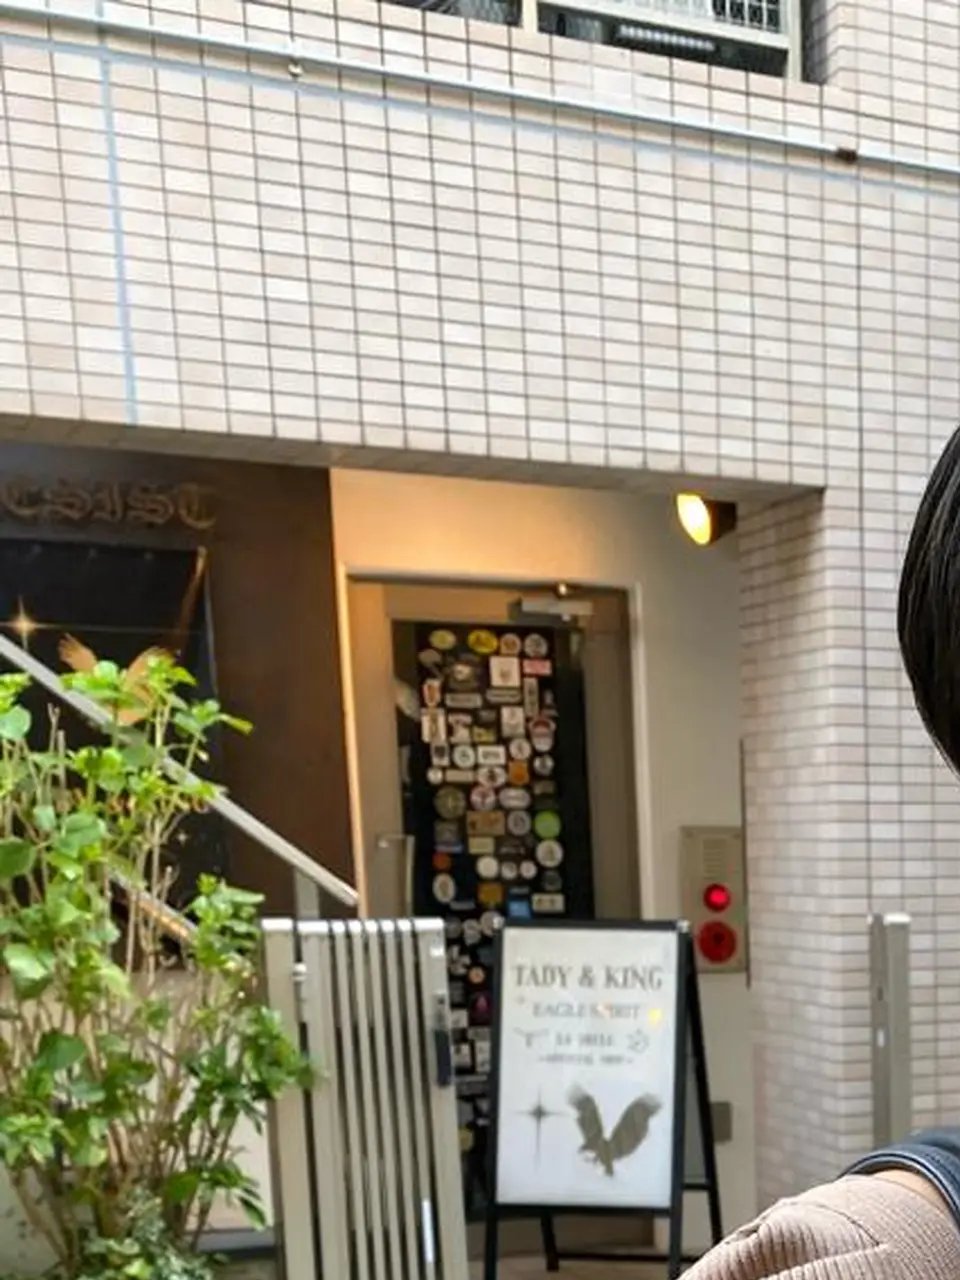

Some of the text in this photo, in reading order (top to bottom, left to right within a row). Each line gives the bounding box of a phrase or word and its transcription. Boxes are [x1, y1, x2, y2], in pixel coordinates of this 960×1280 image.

[512, 964, 663, 993] TADY & KING
